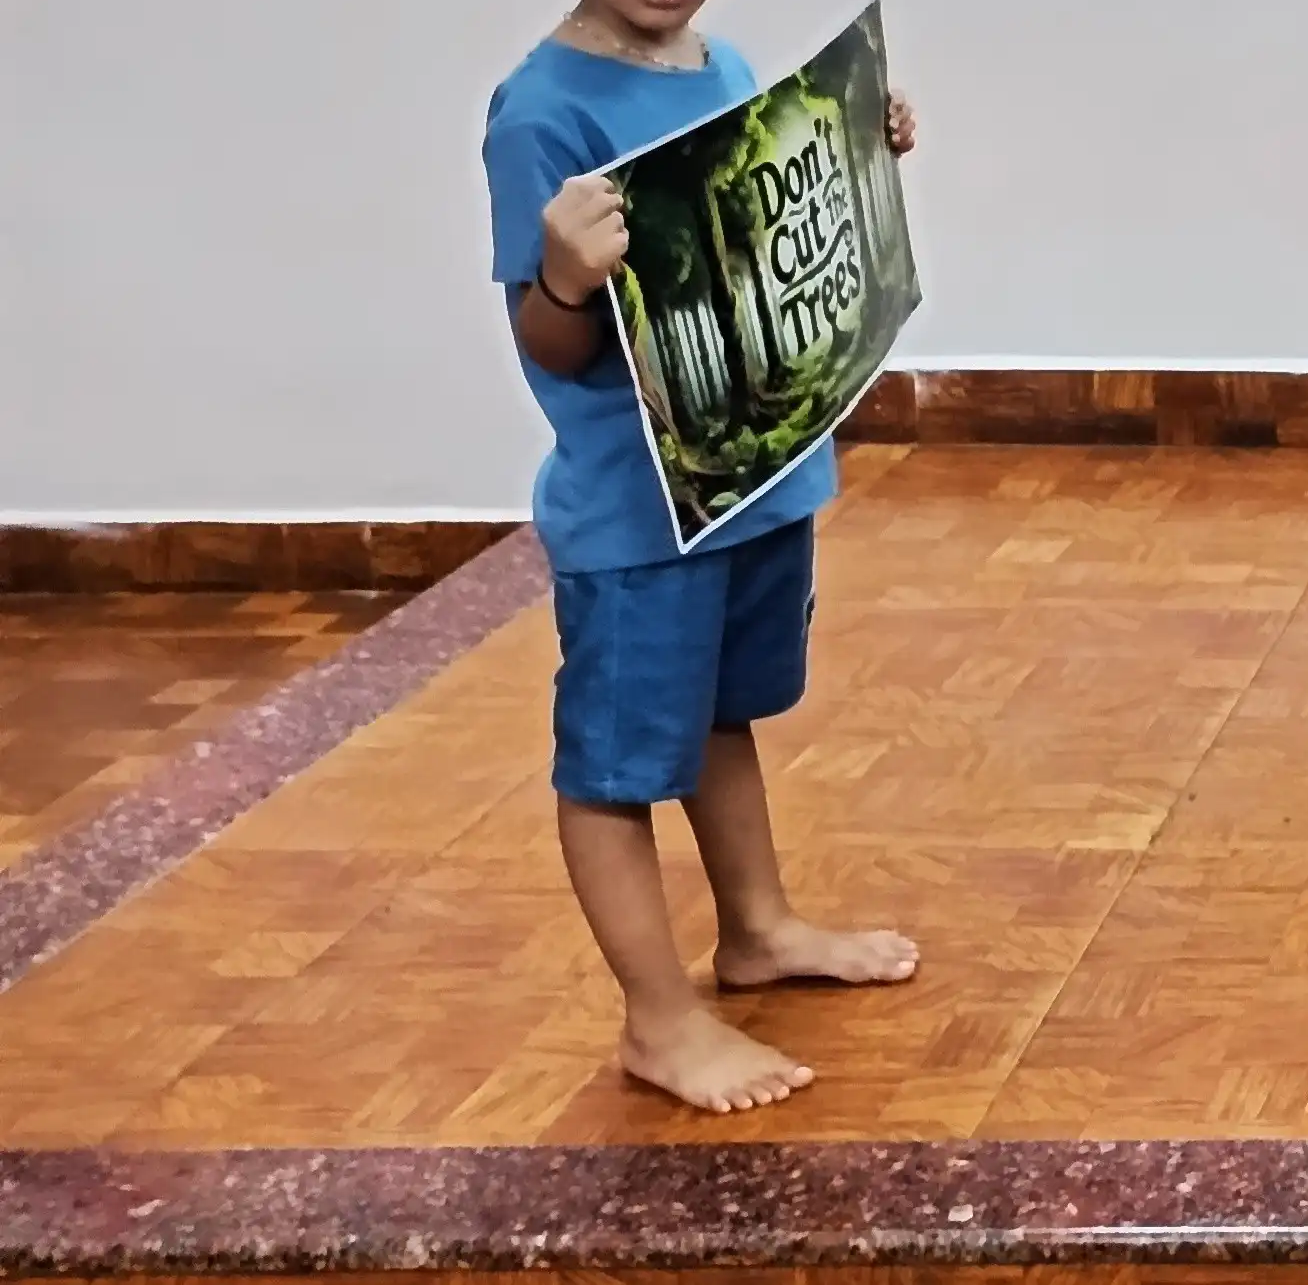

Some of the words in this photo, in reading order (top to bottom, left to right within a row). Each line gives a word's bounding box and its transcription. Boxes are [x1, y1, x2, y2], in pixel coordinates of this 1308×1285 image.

[749, 115, 838, 230] Don't
[770, 196, 827, 285] Cut
[780, 246, 861, 357] Trees
